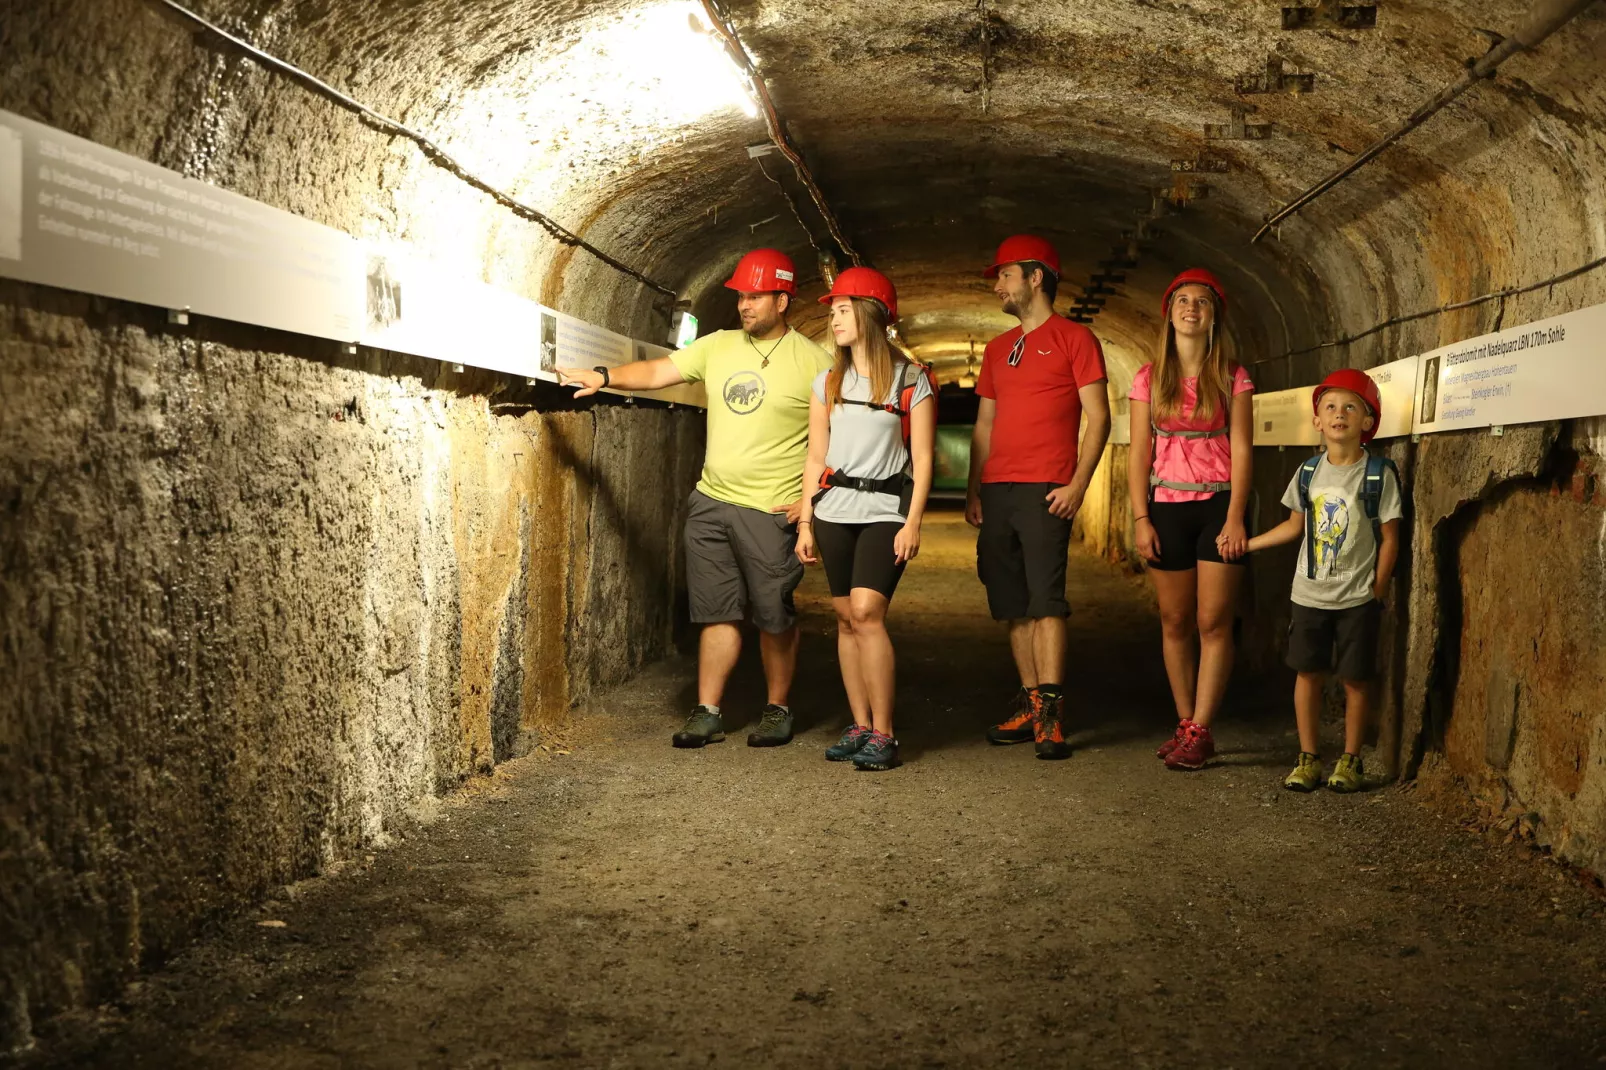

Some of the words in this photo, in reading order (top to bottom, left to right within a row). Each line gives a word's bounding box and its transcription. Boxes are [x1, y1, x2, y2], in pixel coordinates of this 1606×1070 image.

[1477, 344, 1487, 359] mit
[1487, 338, 1518, 359] Nadelquarz
[1518, 335, 1529, 350] LBN
[1530, 331, 1547, 348] 170m
[1548, 324, 1566, 344] Sohle
